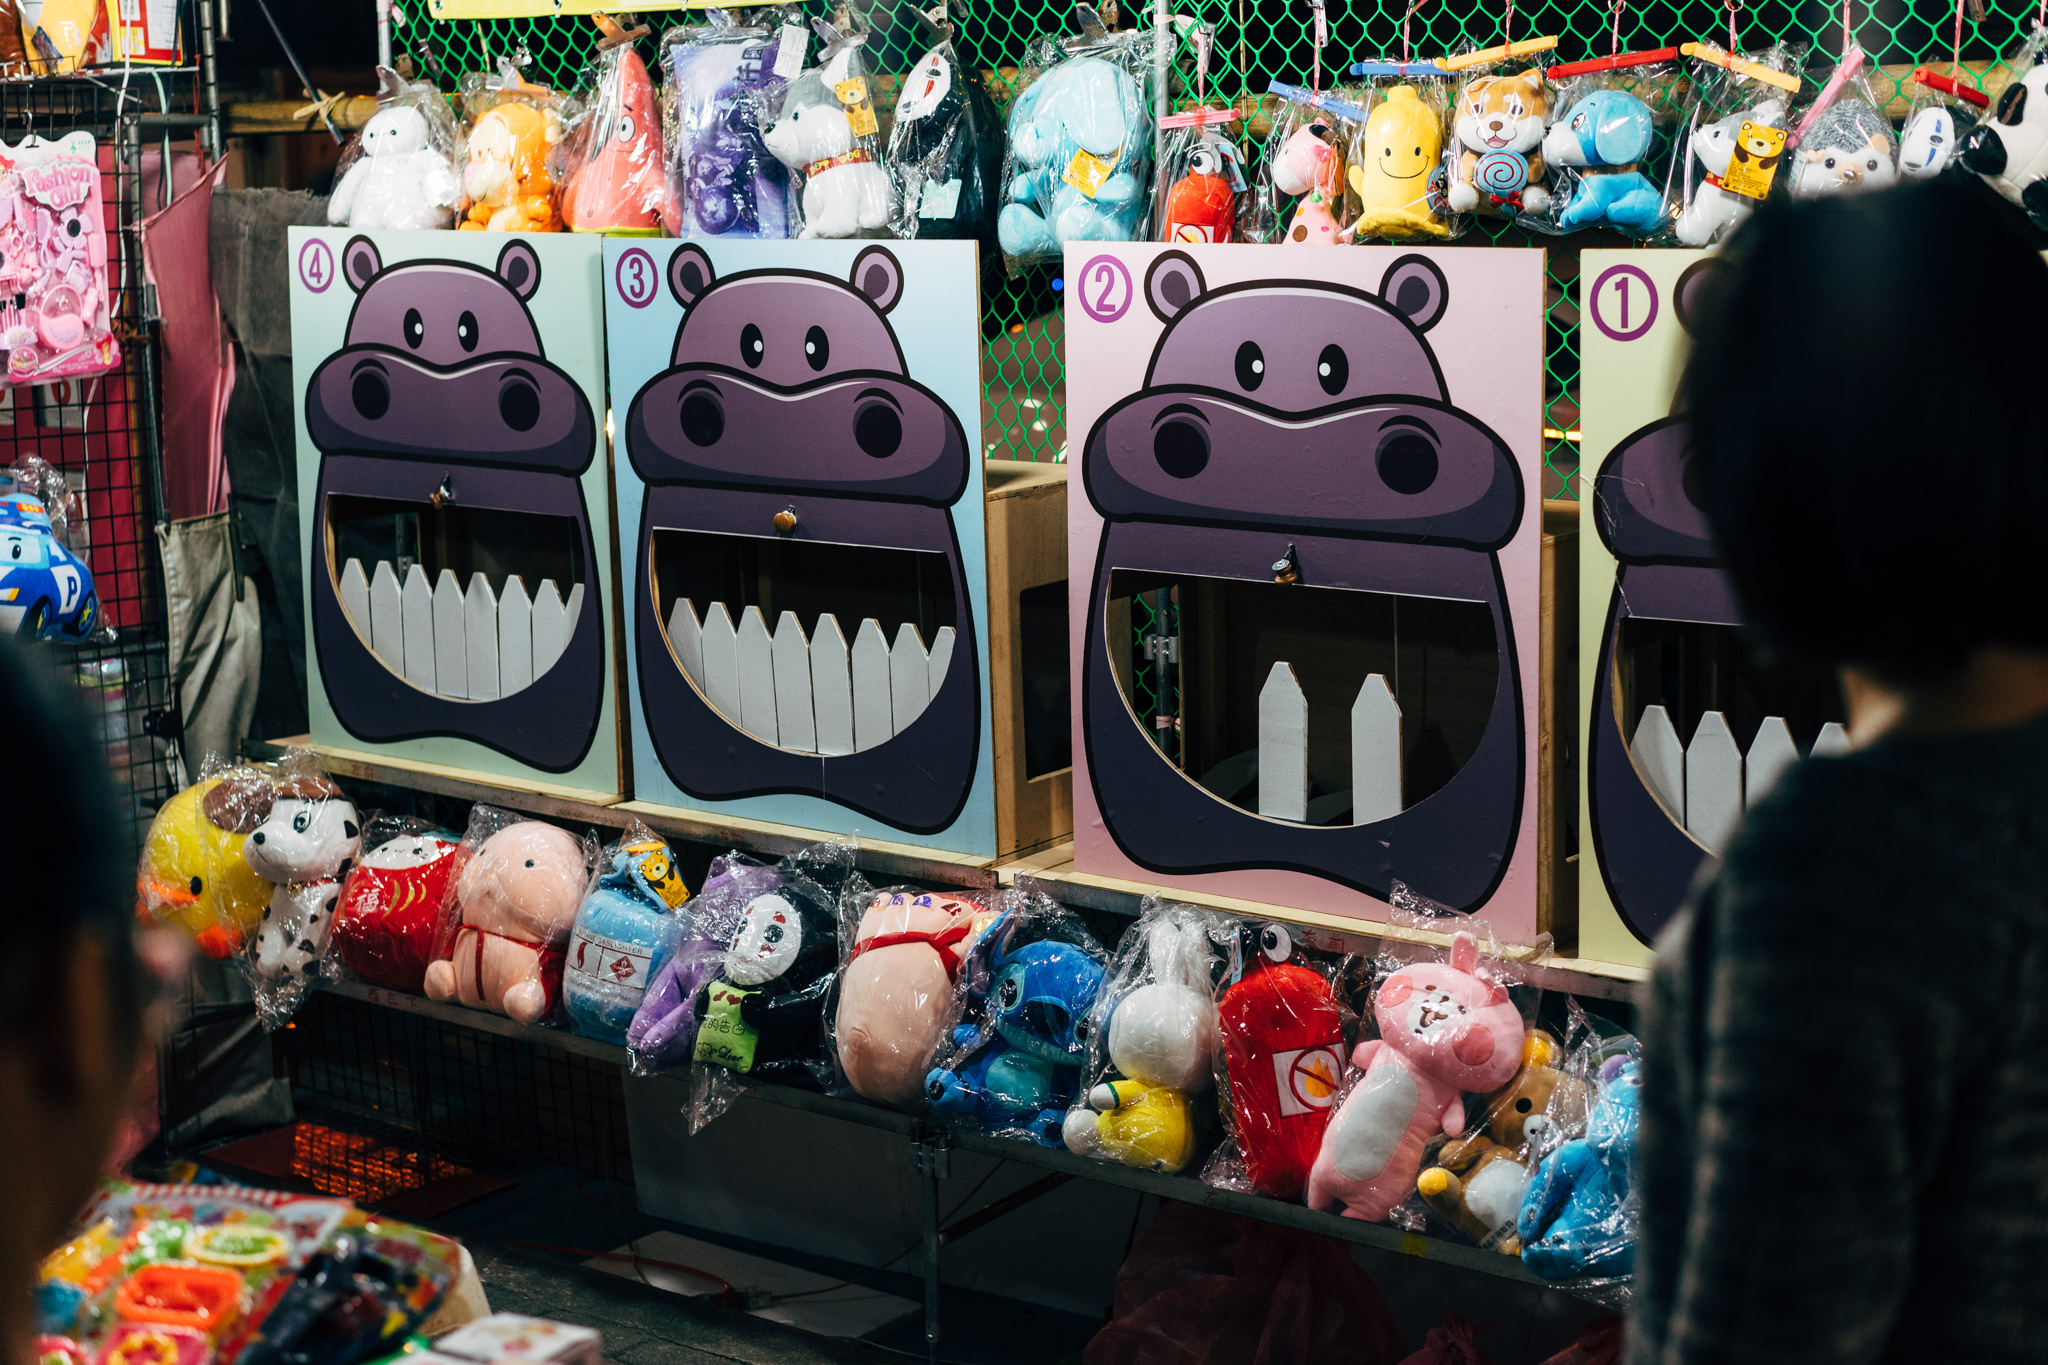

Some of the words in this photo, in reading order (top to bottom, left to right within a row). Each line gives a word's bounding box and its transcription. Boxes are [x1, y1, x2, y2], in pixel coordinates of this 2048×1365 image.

[23, 164, 91, 195] Fashion
[309, 247, 323, 284] 4
[629, 256, 645, 299] 3
[1095, 264, 1116, 312] 2
[1614, 276, 1629, 329] 1
[65, 575, 78, 608] P
[354, 887, 380, 913] 福
